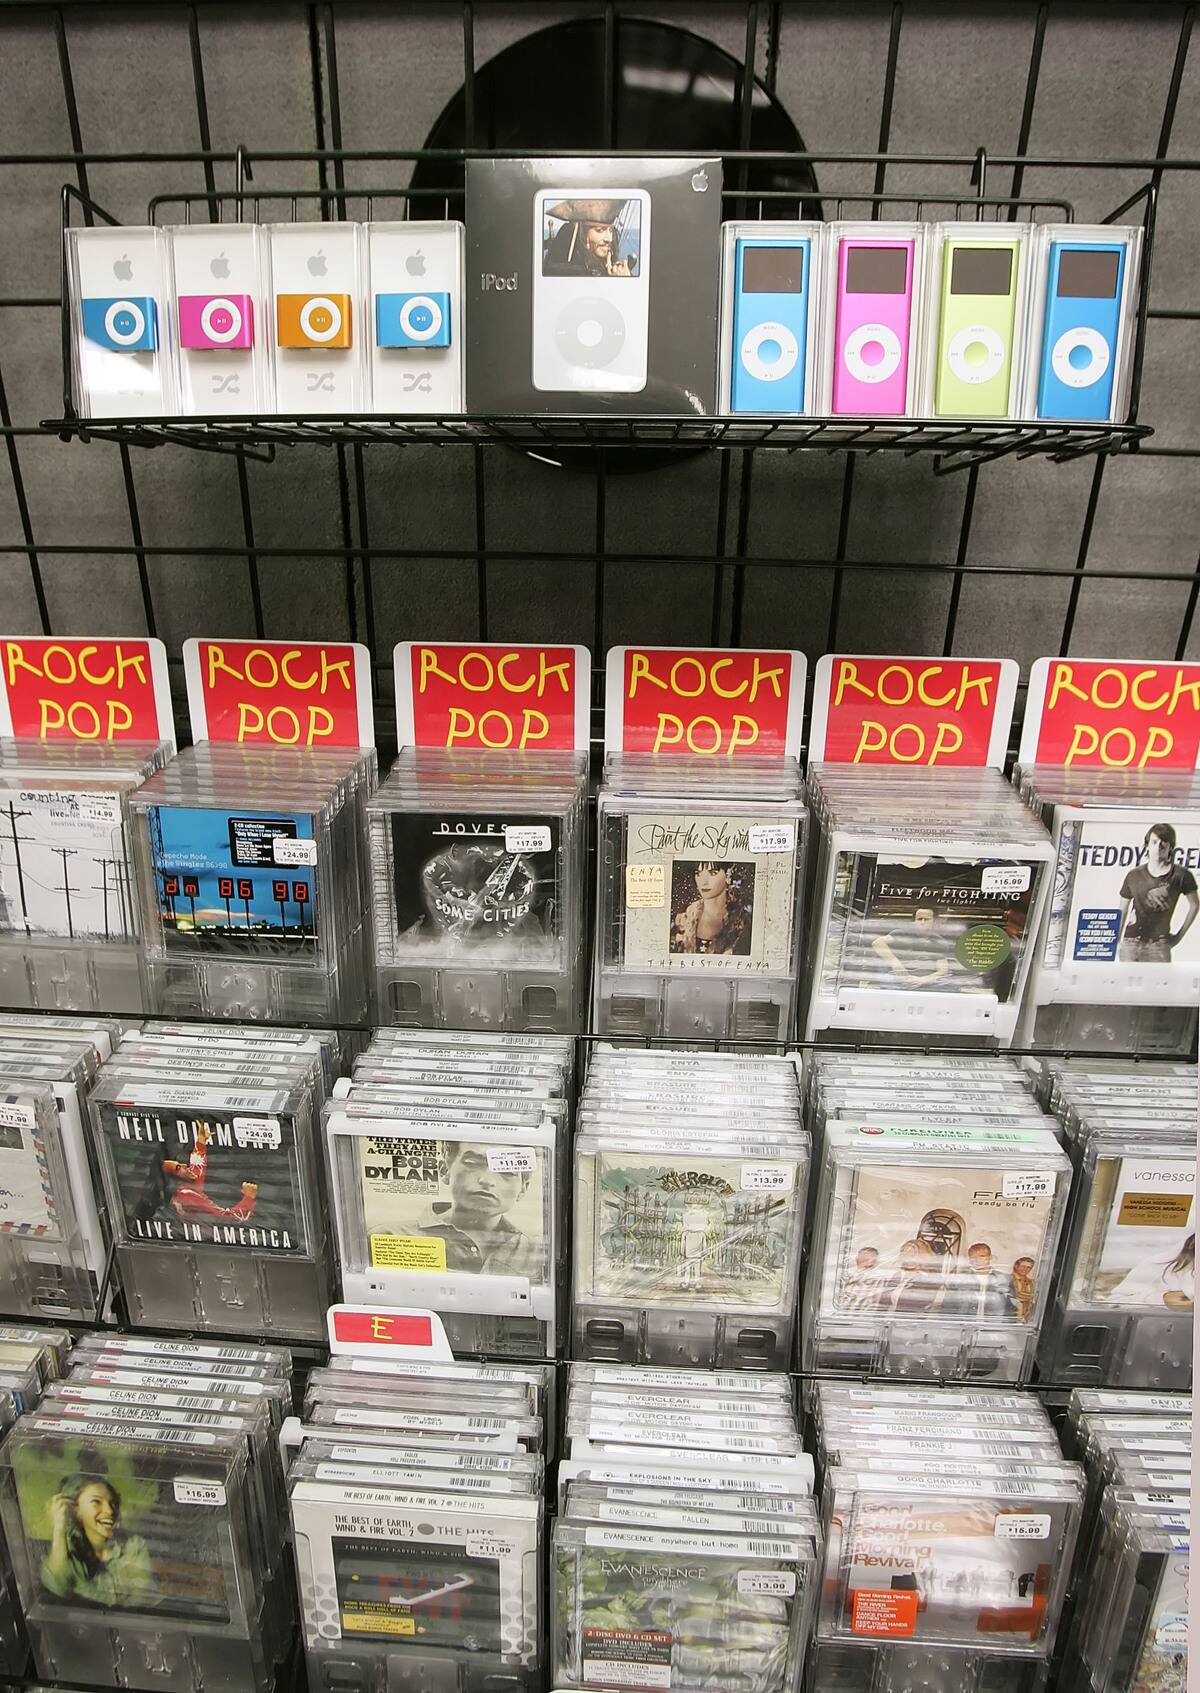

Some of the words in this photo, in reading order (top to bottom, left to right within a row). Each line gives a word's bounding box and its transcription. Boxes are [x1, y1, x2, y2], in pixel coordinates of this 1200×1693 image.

[480, 272, 518, 291] iPod
[7, 642, 148, 690] ROCK
[207, 644, 352, 695] ROCK
[418, 648, 571, 697] ROCK
[628, 652, 784, 703] ROCK
[834, 661, 994, 711] ROCK
[1048, 664, 1200, 715] ROCK
[39, 698, 134, 739] POP
[237, 702, 335, 745] POP
[446, 706, 550, 748] POP
[652, 713, 760, 755] POP
[854, 721, 964, 764] POP
[1064, 723, 1174, 768] POP
[20, 792, 77, 804] counting
[50, 810, 64, 818] live
[89, 810, 113, 818] $14.99
[440, 823, 508, 834] DOVES
[682, 822, 699, 848] the
[700, 822, 731, 858] Sky
[1080, 845, 1148, 867] TEDDY
[631, 867, 662, 876] ENYA
[221, 880, 250, 897] 86
[276, 882, 306, 900] 98
[917, 886, 939, 899] for
[943, 888, 1021, 901] FIGHTING
[435, 900, 475, 921] SOME
[483, 901, 530, 922] CITIES
[680, 959, 713, 968] BEST
[736, 961, 770, 971] ENYA
[1, 1115, 27, 1123] $17.99
[117, 1116, 165, 1142] NEIL
[245, 1131, 273, 1139] $24.99
[367, 1148, 441, 1157] A-CHANGIN'
[374, 1142, 408, 1150] THEY
[392, 1156, 438, 1169] BOB
[365, 1166, 439, 1182] DYLAN
[1134, 1171, 1196, 1182] vanessa
[136, 1219, 173, 1239] LIVE
[184, 1223, 202, 1242] IN
[213, 1225, 292, 1249] AMERICA
[370, 1315, 395, 1340] E
[153, 1342, 181, 1350] CELINE
[182, 1344, 200, 1352] DION
[144, 1358, 172, 1366] CELINE
[141, 1376, 169, 1384] CELINE
[109, 1390, 137, 1398] CELINE
[138, 1392, 158, 1400] DION
[628, 1395, 690, 1404] EVERCLEAR
[111, 1407, 139, 1415] CELINE
[140, 1409, 161, 1417] DION
[628, 1412, 691, 1421] EVERCLEAR
[86, 1422, 113, 1431] CELINE
[915, 1426, 962, 1434] FERDINAND
[642, 1430, 686, 1439] EVERCLEAR
[909, 1441, 945, 1449] FRANKIE
[670, 1451, 729, 1461] EVERCLEAR
[629, 1473, 672, 1481] EXPLOSIONS
[926, 1478, 982, 1486] CHARLOTTE
[394, 1495, 408, 1503] WIND
[609, 1507, 658, 1519] EVANESCENCE
[682, 1515, 710, 1524] FALLEN
[862, 1504, 913, 1515] Good
[334, 1515, 350, 1524] THE
[352, 1516, 370, 1525] BEST
[373, 1517, 383, 1526] OF
[386, 1518, 414, 1529] EARTH,
[437, 1526, 462, 1536] THE
[335, 1524, 356, 1532] WIND
[359, 1525, 366, 1533] &
[369, 1526, 385, 1535] FIRE
[388, 1527, 406, 1536] VOL.
[409, 1529, 414, 1537] 2
[861, 1517, 947, 1532] Charlotte.
[603, 1532, 654, 1542] EVANESCENCE
[661, 1539, 698, 1547] anywhere
[702, 1539, 715, 1548] but
[853, 1543, 931, 1558] Morning
[601, 1559, 707, 1580] EVANESCENCE
